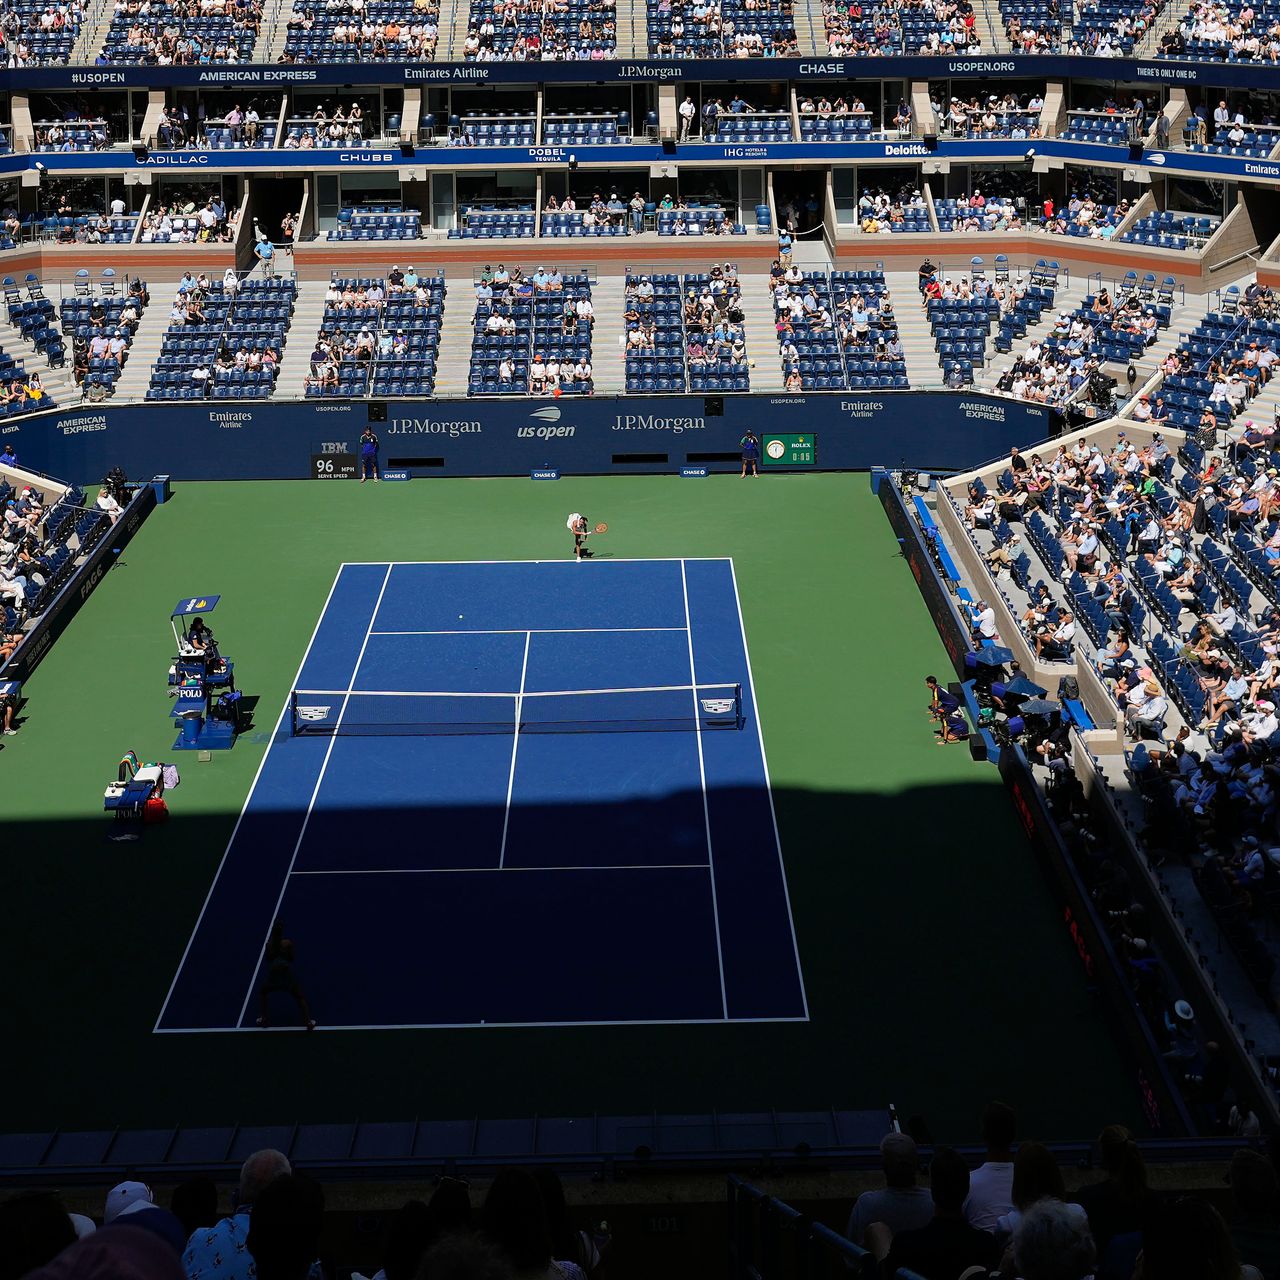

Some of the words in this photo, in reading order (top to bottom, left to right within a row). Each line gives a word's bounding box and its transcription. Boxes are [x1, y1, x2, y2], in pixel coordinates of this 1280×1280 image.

[799, 63, 845, 74] CHASE
[949, 61, 1015, 72] USOPEN.ORG
[71, 72, 125, 83] #USOPEN
[199, 71, 261, 82] AMERICAN
[263, 70, 317, 81] EXPRESS
[404, 67, 451, 80] Emirates
[453, 67, 489, 78] Airline
[618, 66, 683, 80] J.P.Morgan
[1160, 68, 1176, 78] ONLY
[1176, 69, 1188, 79] ONE
[340, 153, 393, 163] CHUBB
[528, 148, 566, 156] DOBEL
[724, 148, 744, 157] IHG
[135, 155, 208, 165] CADILLAC
[1245, 163, 1279, 176] Emirates
[840, 400, 884, 411] Emirates
[959, 402, 1006, 415] AMERICAN
[209, 410, 253, 422] Emirates
[850, 410, 875, 418] Airline
[965, 410, 1006, 422] EXPRESS
[1026, 407, 1043, 417] USTA
[56, 415, 106, 429] AMERICAN
[219, 421, 243, 429] Airline
[387, 418, 483, 438] J.P.Morgan
[611, 414, 706, 434] J.P.Morgan
[0, 425, 20, 435] USTA
[63, 422, 108, 435] EXPRESS
[517, 426, 536, 438] us
[536, 425, 577, 441] open
[320, 441, 348, 454] IBM
[316, 459, 334, 473] 96
[179, 688, 203, 699] POLO
[647, 1215, 681, 1232] 101
